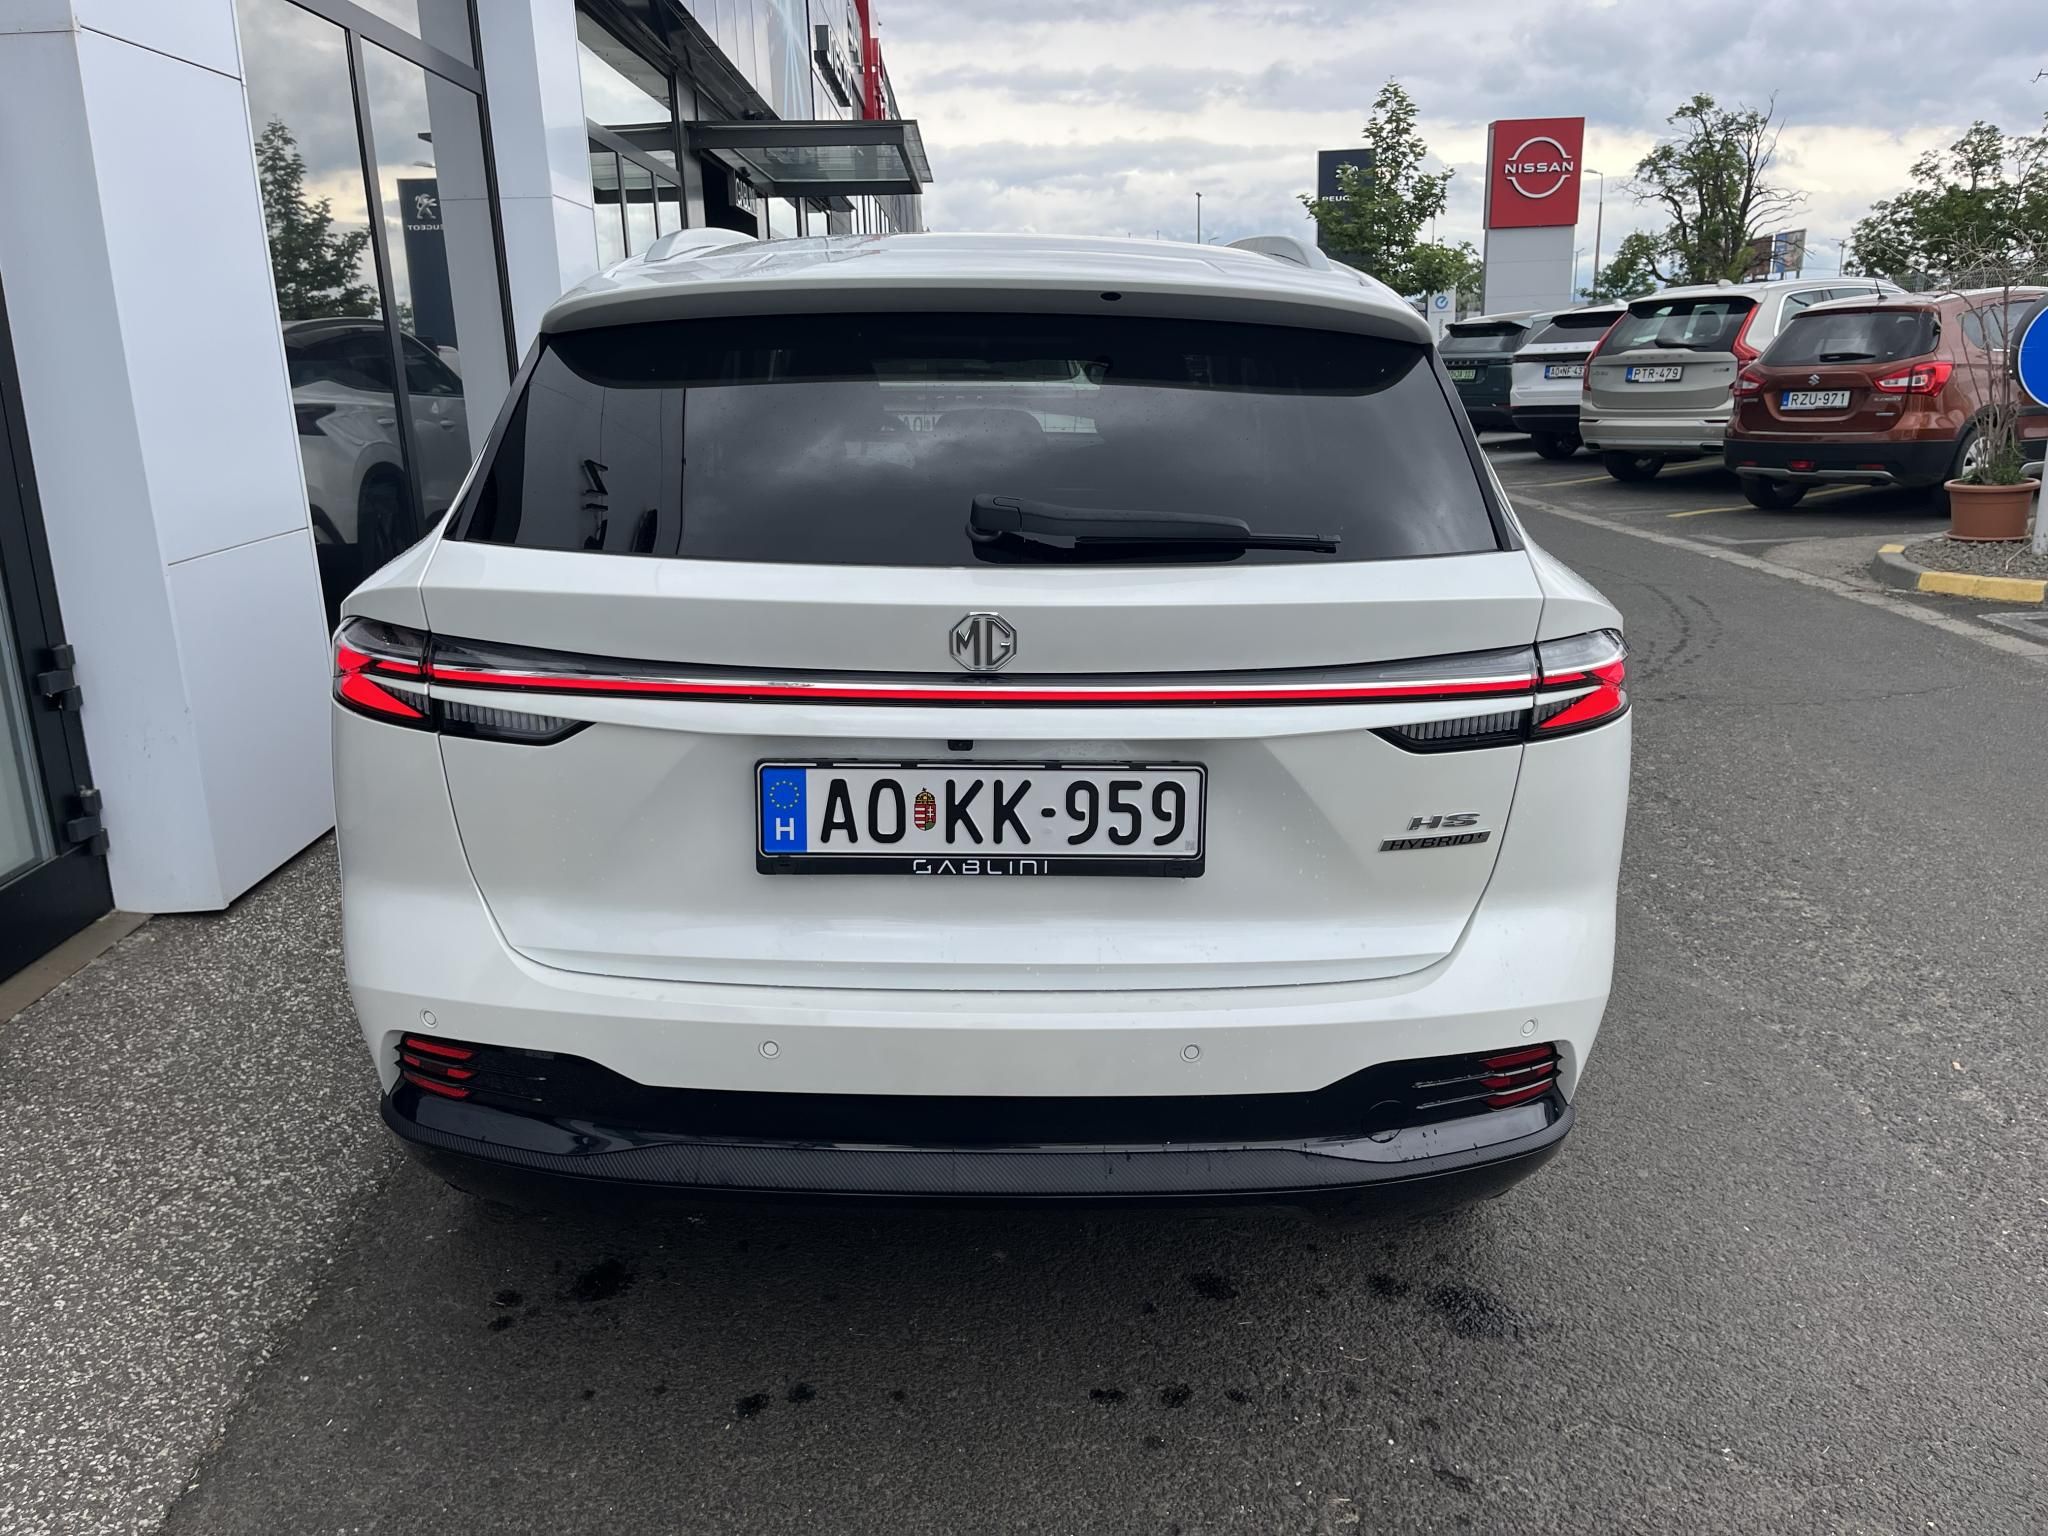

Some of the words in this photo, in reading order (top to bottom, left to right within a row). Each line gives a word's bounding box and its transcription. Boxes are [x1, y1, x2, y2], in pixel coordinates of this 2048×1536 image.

[1504, 161, 1574, 174] NISSAN
[1321, 194, 1351, 202] PEUG
[1562, 366, 1583, 376] NF-43
[1633, 367, 1679, 379] PTR-479
[1790, 392, 1846, 406] RZU-971
[955, 616, 1011, 667] MG
[945, 779, 1186, 846] KK-959
[1407, 811, 1481, 831] HS
[775, 817, 795, 841] H
[912, 859, 1048, 875] GABLINI
